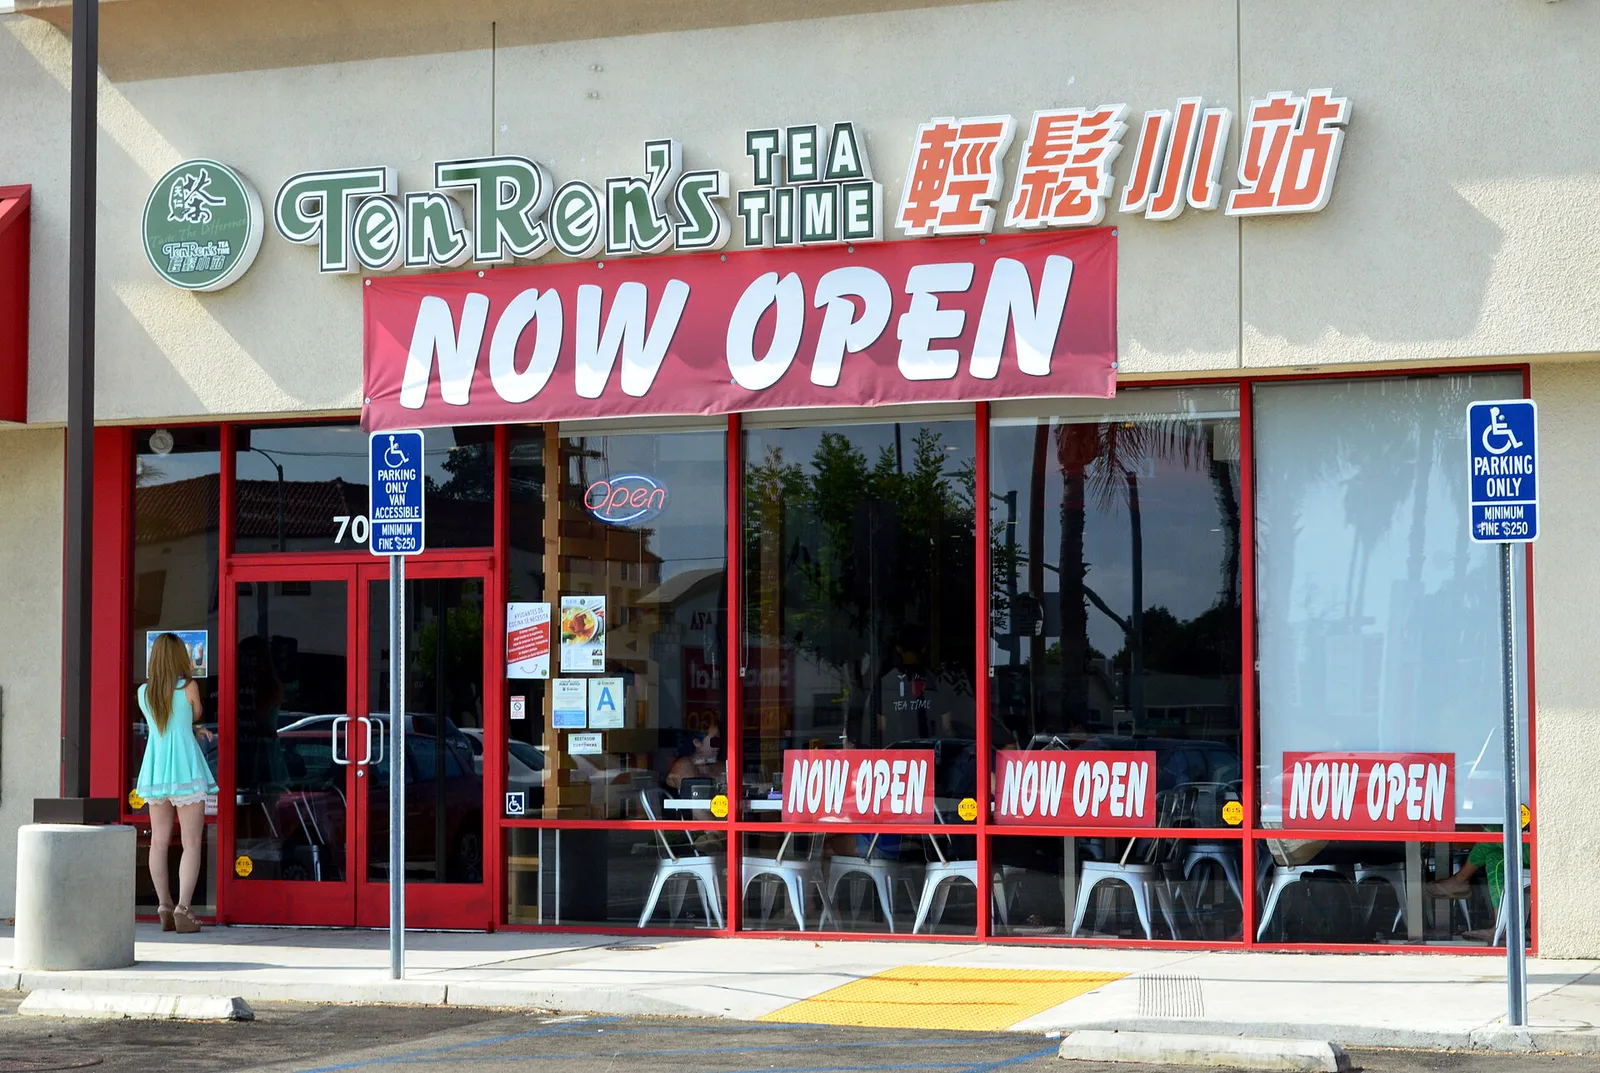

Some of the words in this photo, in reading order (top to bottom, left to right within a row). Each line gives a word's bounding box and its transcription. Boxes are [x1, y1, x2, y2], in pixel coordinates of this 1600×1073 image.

[746, 121, 866, 186] TEA
[895, 88, 1350, 236] 輕鬆小站
[737, 181, 878, 248] TIME
[400, 278, 690, 409] NOW
[725, 254, 1073, 391] OPEN
[378, 469, 416, 481] PARKING
[1474, 454, 1533, 476] PARKING
[385, 482, 408, 493] ONLY
[584, 481, 665, 515] Open
[1486, 477, 1522, 498] ONLY
[389, 494, 406, 506] VAN
[375, 506, 419, 518] ACCESSIBLE
[1484, 505, 1524, 520] MINIMUM
[382, 524, 413, 535] MINIMUM
[1480, 522, 1500, 536] FINE
[1501, 521, 1529, 537] $250
[378, 537, 394, 550] FINE
[394, 536, 416, 550] $250
[596, 686, 616, 711] A
[893, 700, 908, 711] TEA
[910, 699, 931, 710] TIME
[787, 758, 850, 815] NOW
[854, 758, 928, 815] OPEN
[1001, 760, 1066, 817] NOW
[1073, 760, 1149, 818] OPEN
[1289, 761, 1359, 821] NOW
[1366, 762, 1447, 822] OPEN
